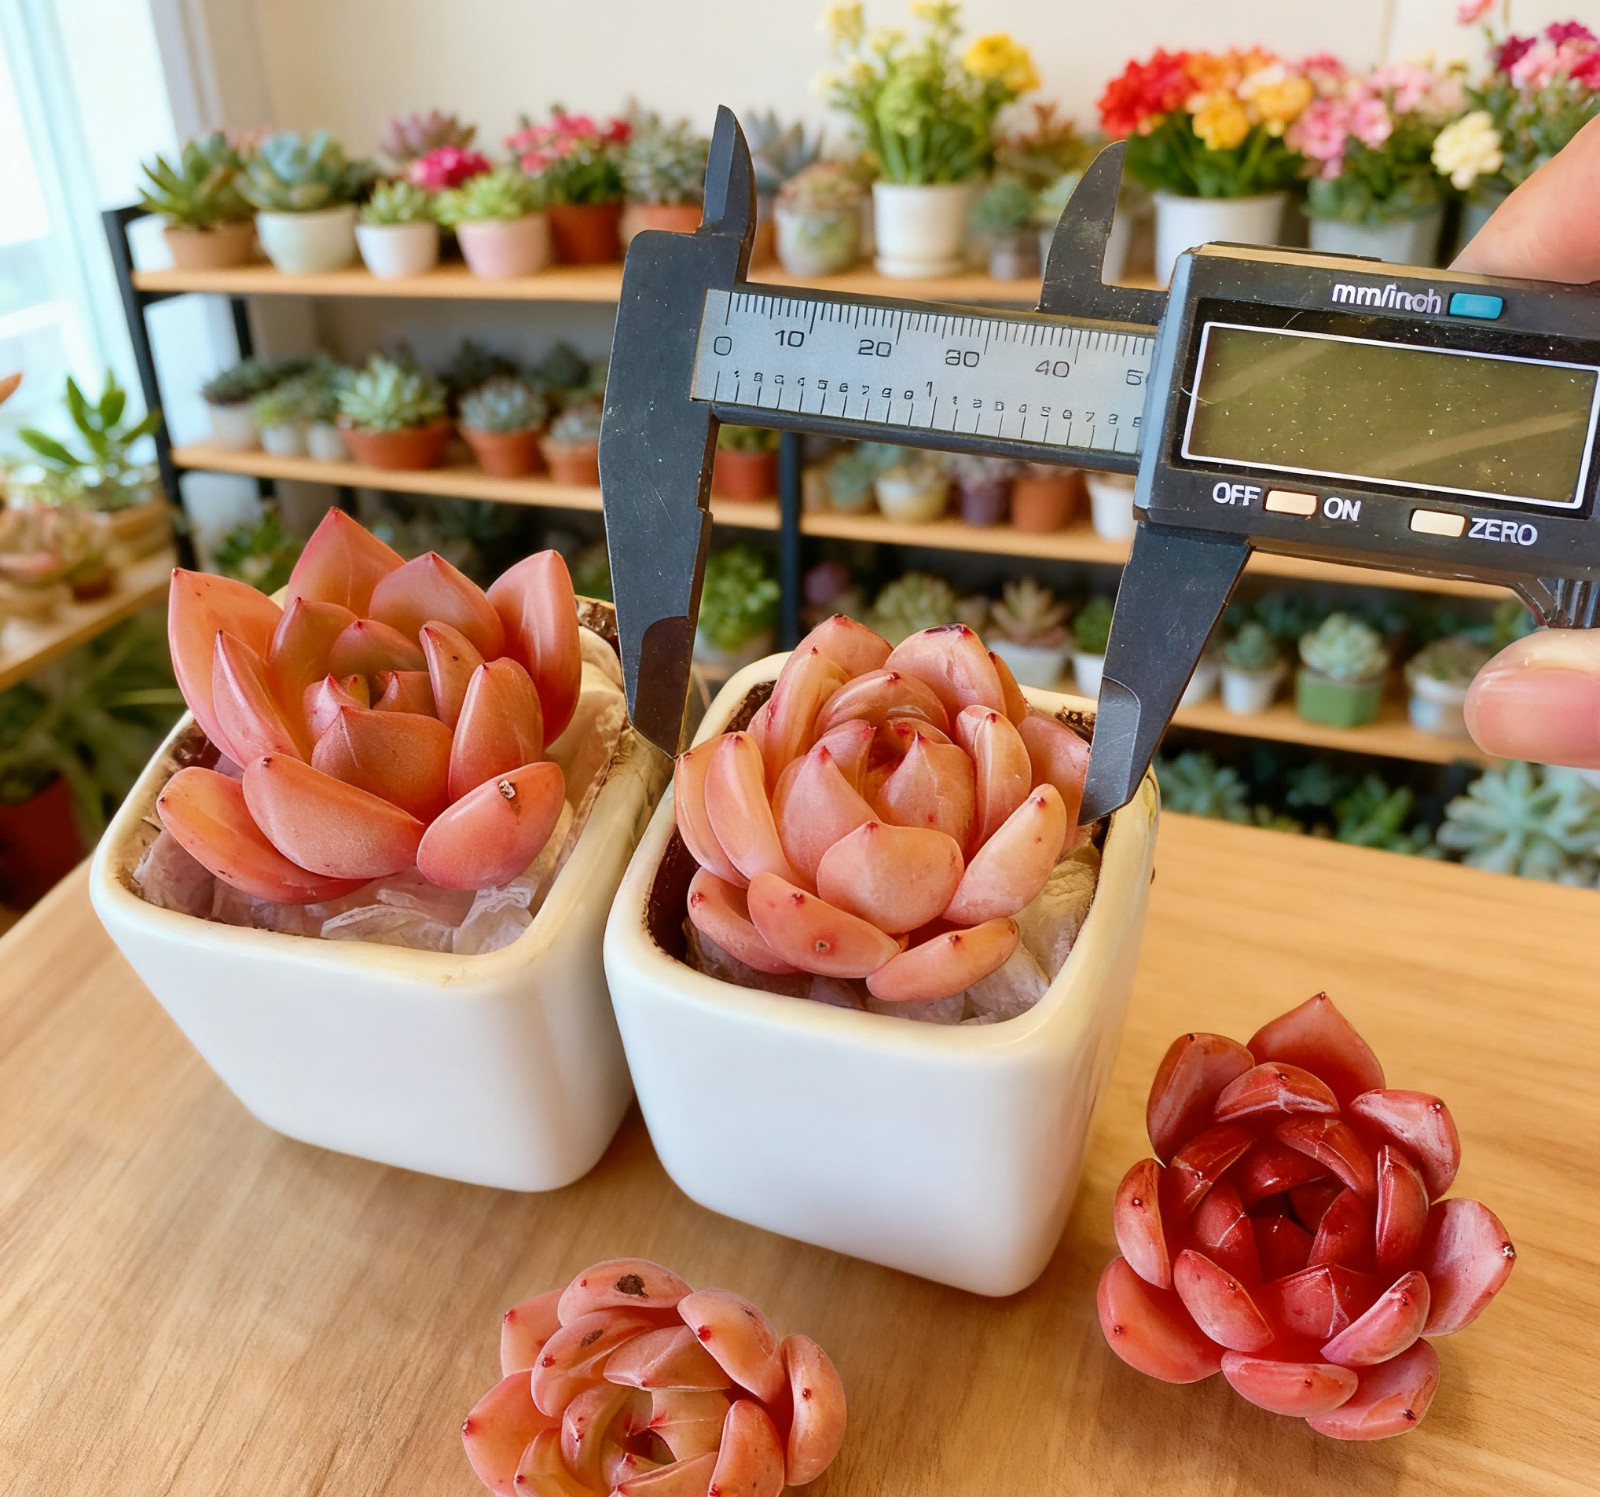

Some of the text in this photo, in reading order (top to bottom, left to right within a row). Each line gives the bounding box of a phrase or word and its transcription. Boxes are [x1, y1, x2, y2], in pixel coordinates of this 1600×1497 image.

[713, 336, 733, 356] 0
[774, 329, 805, 348] 10
[857, 339, 892, 358] 20
[1035, 359, 1070, 378] 40
[1212, 481, 1261, 507] OFF
[1323, 497, 1361, 522] ON
[1467, 517, 1538, 546] ZERO
